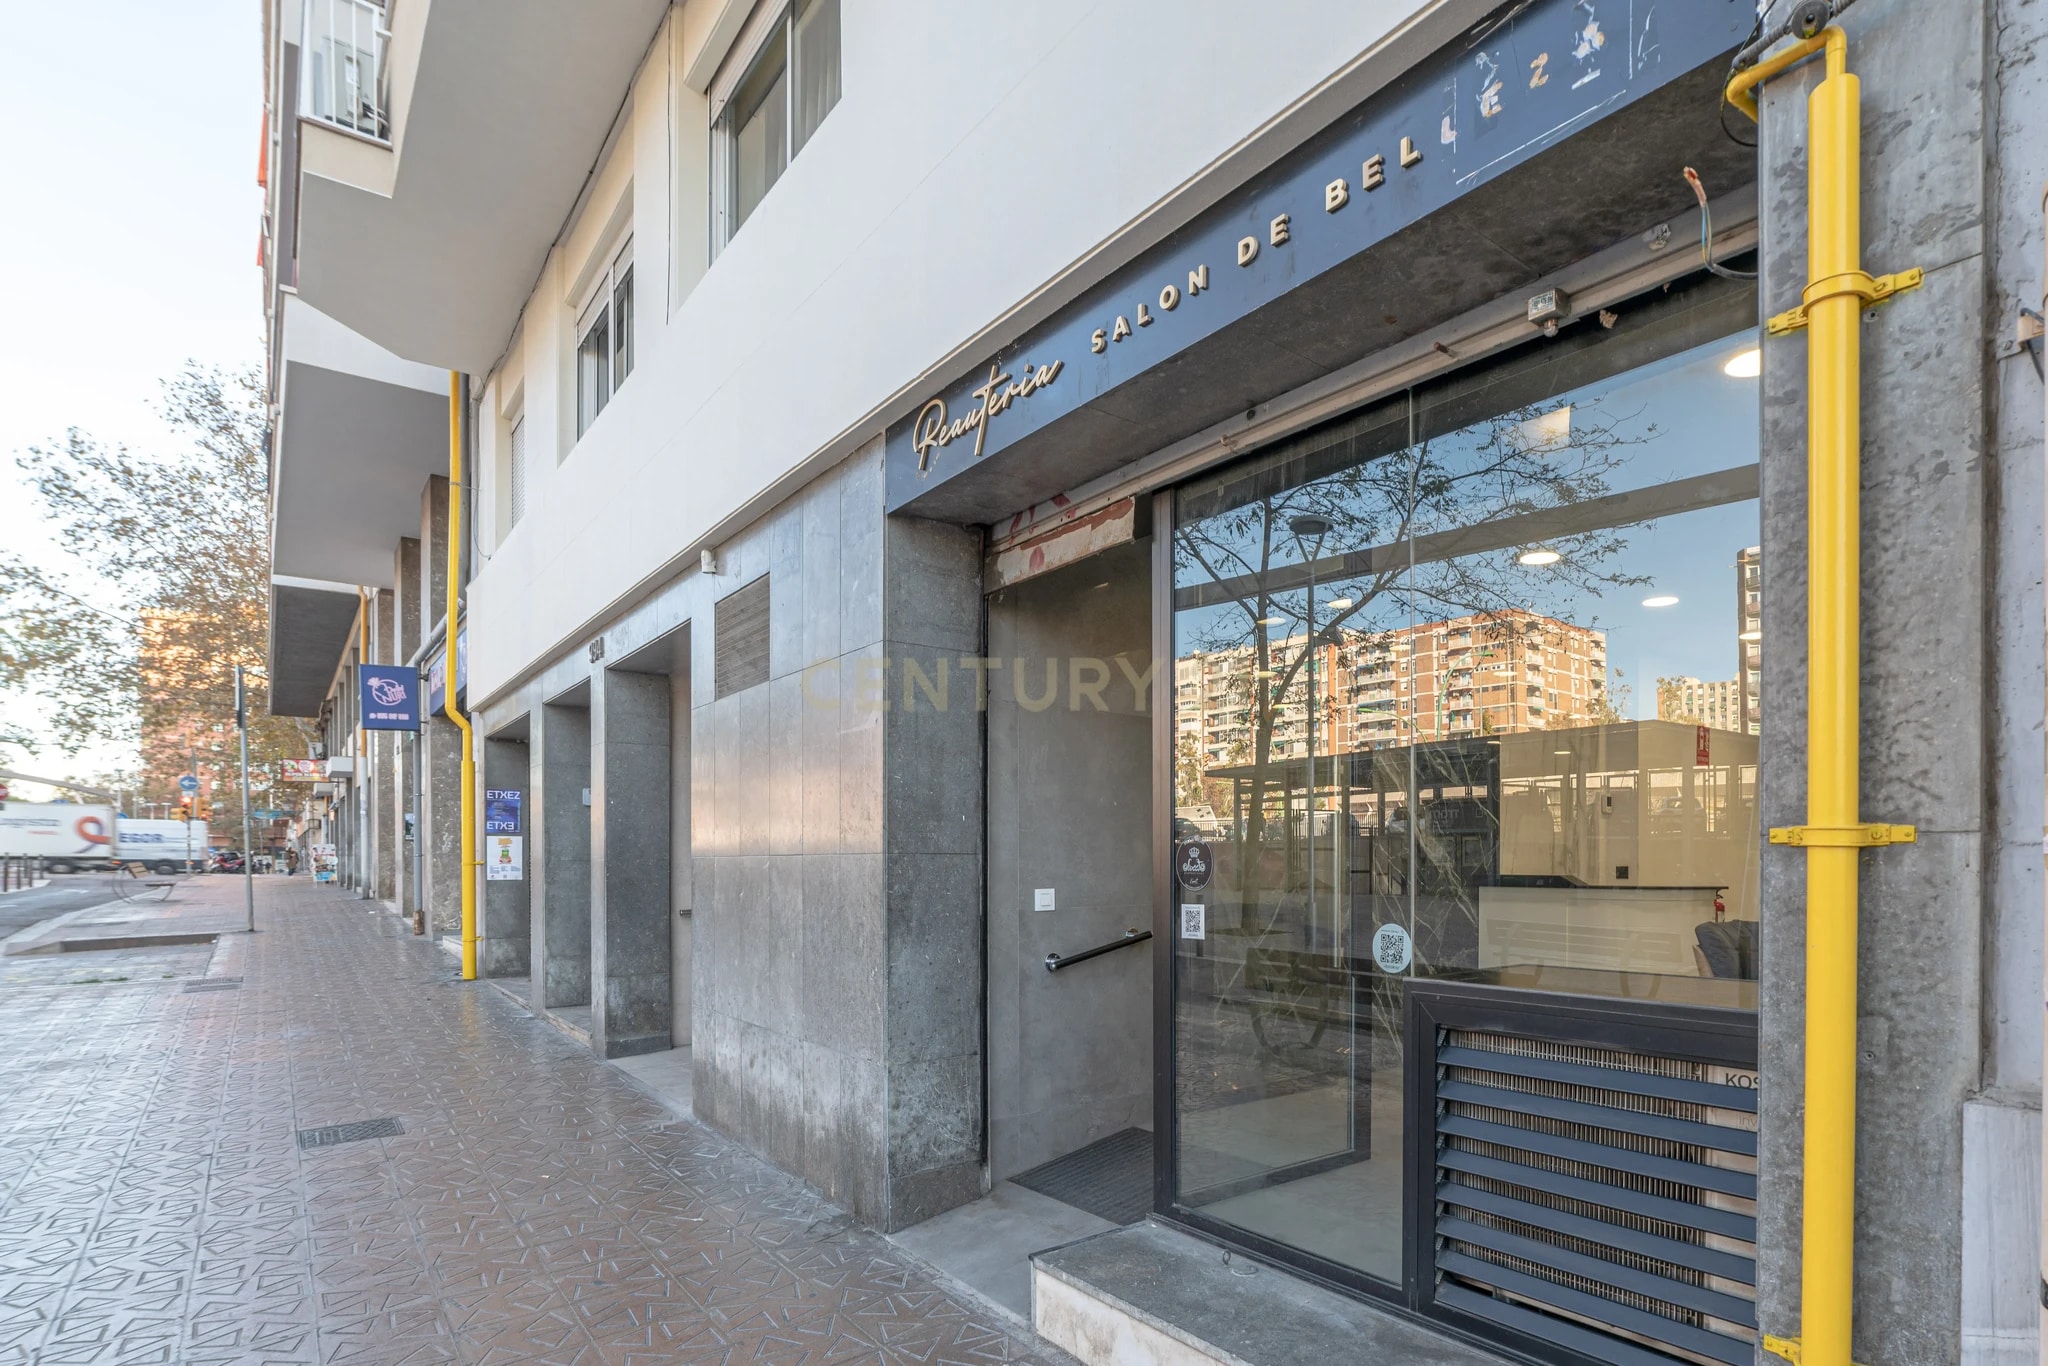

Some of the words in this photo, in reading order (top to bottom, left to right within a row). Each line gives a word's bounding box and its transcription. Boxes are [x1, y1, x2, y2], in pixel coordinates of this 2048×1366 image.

[1092, 264, 1209, 354] SALON
[1238, 213, 1291, 267] DE
[486, 790, 520, 800] ETXEZ
